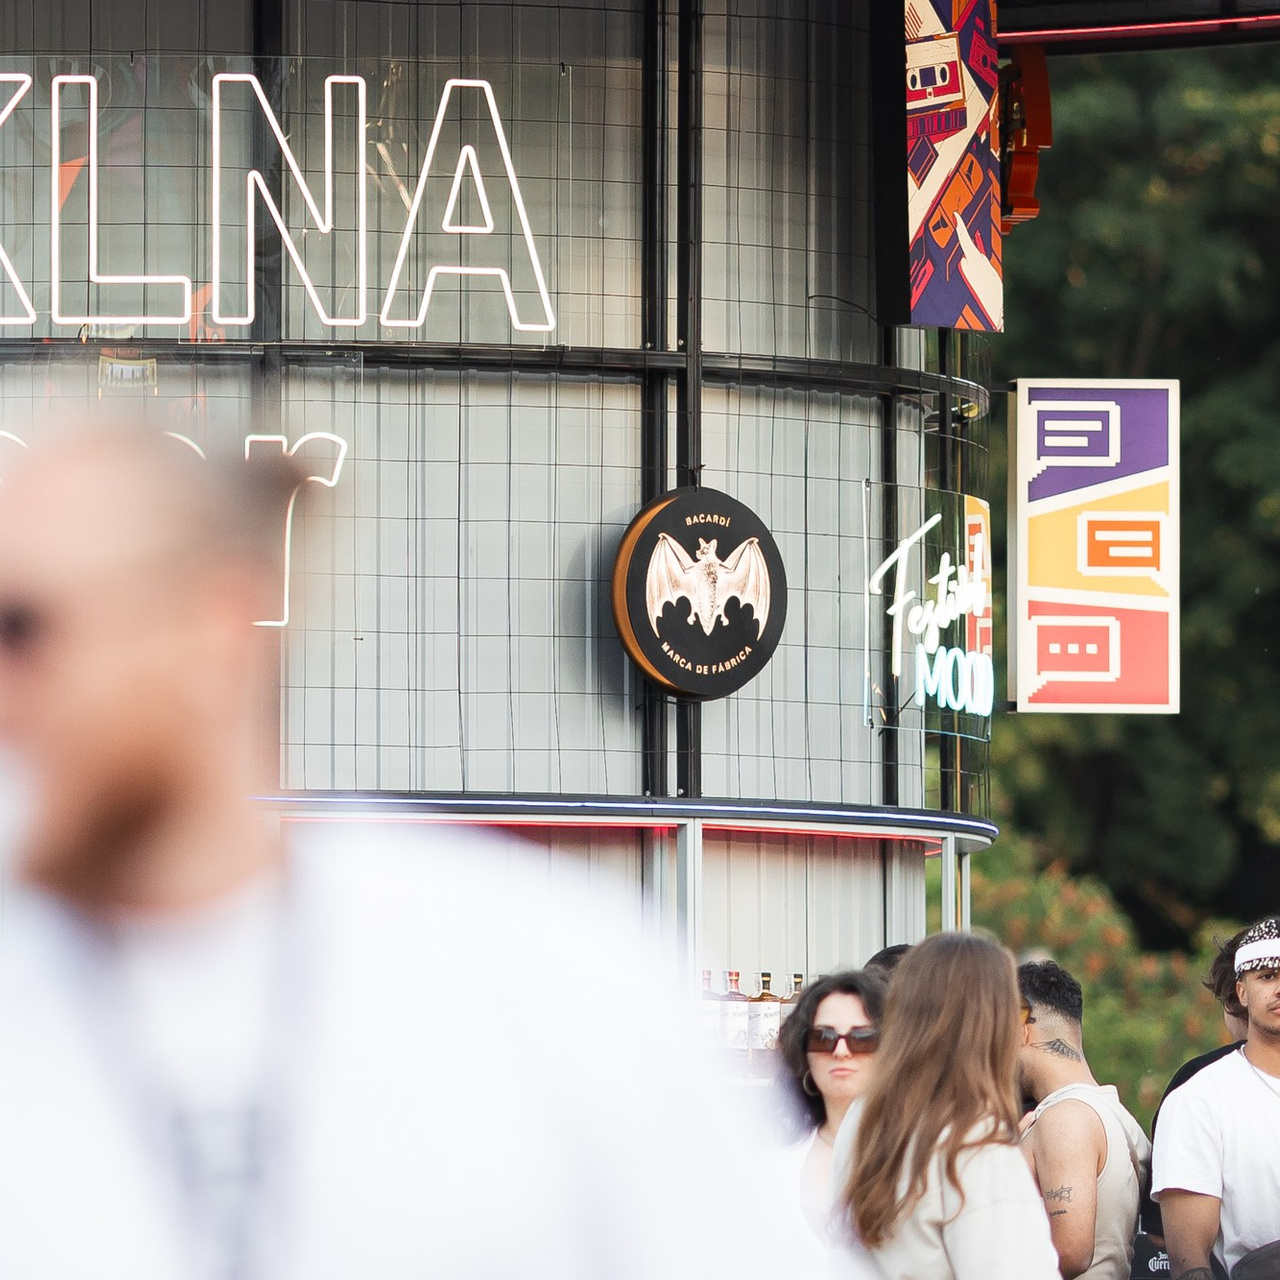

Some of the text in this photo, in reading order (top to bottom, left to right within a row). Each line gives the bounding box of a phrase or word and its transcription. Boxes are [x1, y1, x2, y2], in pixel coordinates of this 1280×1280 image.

[684, 513, 732, 528] BACARDÍ
[661, 641, 693, 672] MARCA
[695, 664, 709, 675] DE
